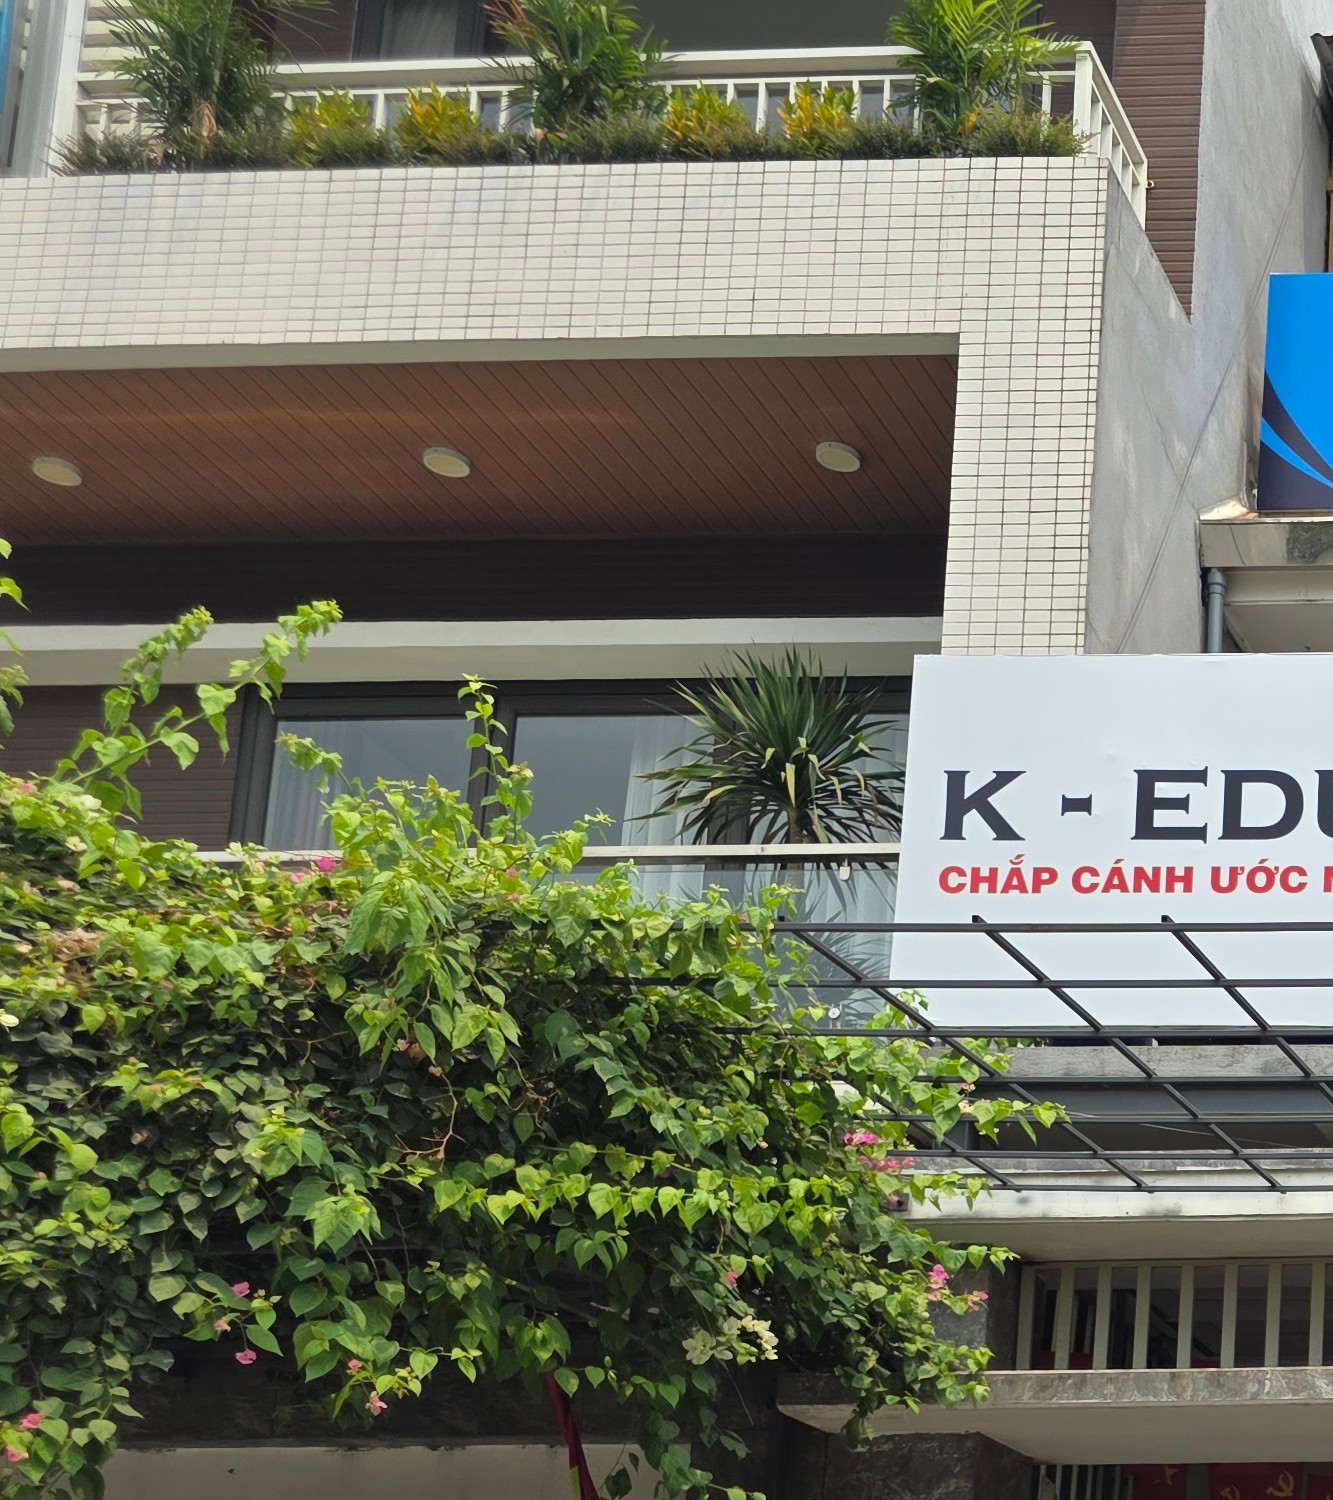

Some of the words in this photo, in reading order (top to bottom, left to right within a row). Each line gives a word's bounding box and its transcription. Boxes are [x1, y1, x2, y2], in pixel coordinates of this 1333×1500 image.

[939, 769, 1027, 842] K
[938, 854, 1059, 895] CHẮP
[1071, 859, 1194, 895] CÁNH
[1210, 858, 1308, 894] ƯỚC
